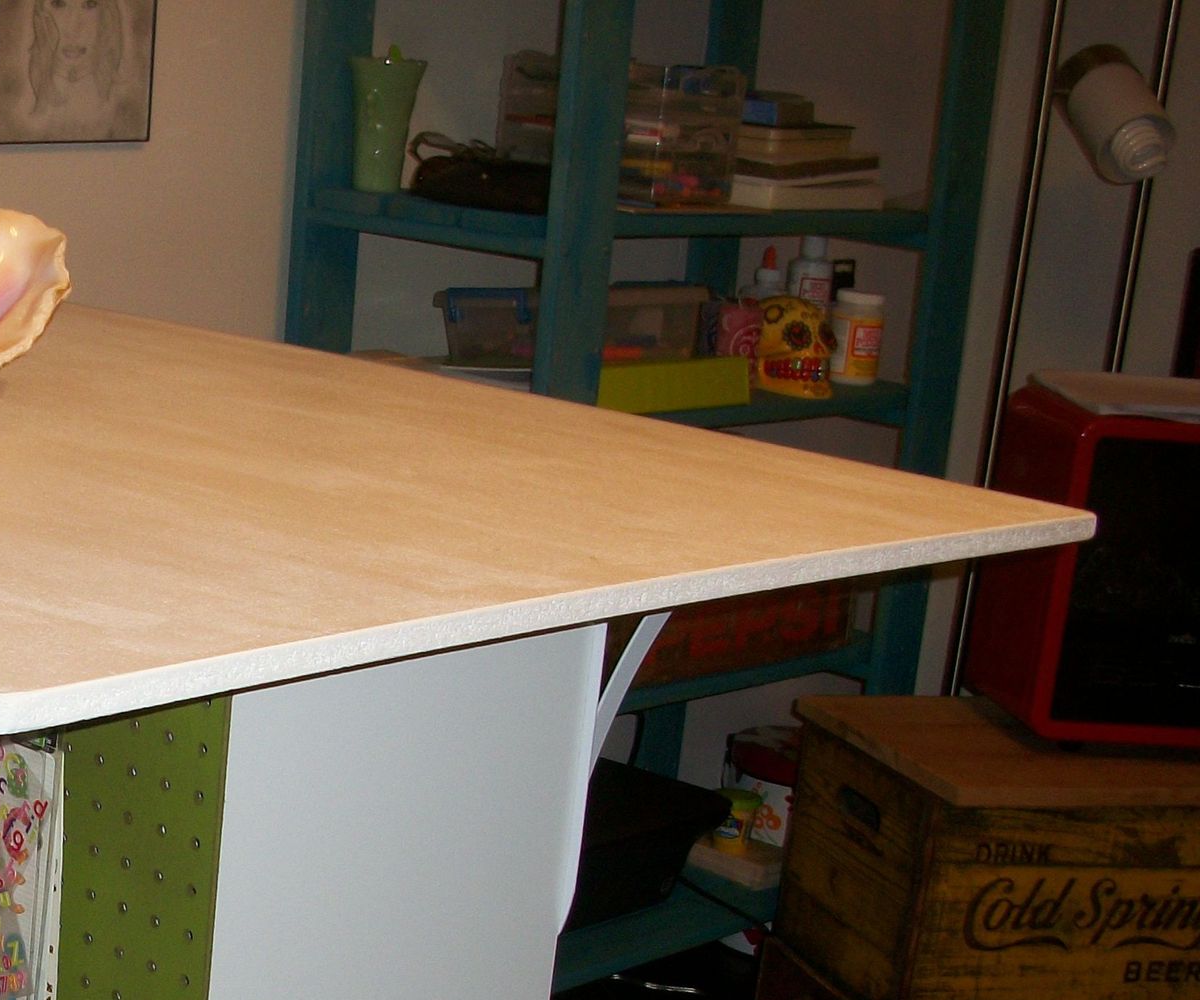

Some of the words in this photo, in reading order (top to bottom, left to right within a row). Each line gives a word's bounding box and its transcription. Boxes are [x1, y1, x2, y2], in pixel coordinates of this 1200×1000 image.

[975, 842, 1055, 862] DRINK
[963, 877, 1075, 952] Cold
[1072, 877, 1200, 952] Sprin
[1122, 960, 1200, 983] BEER
